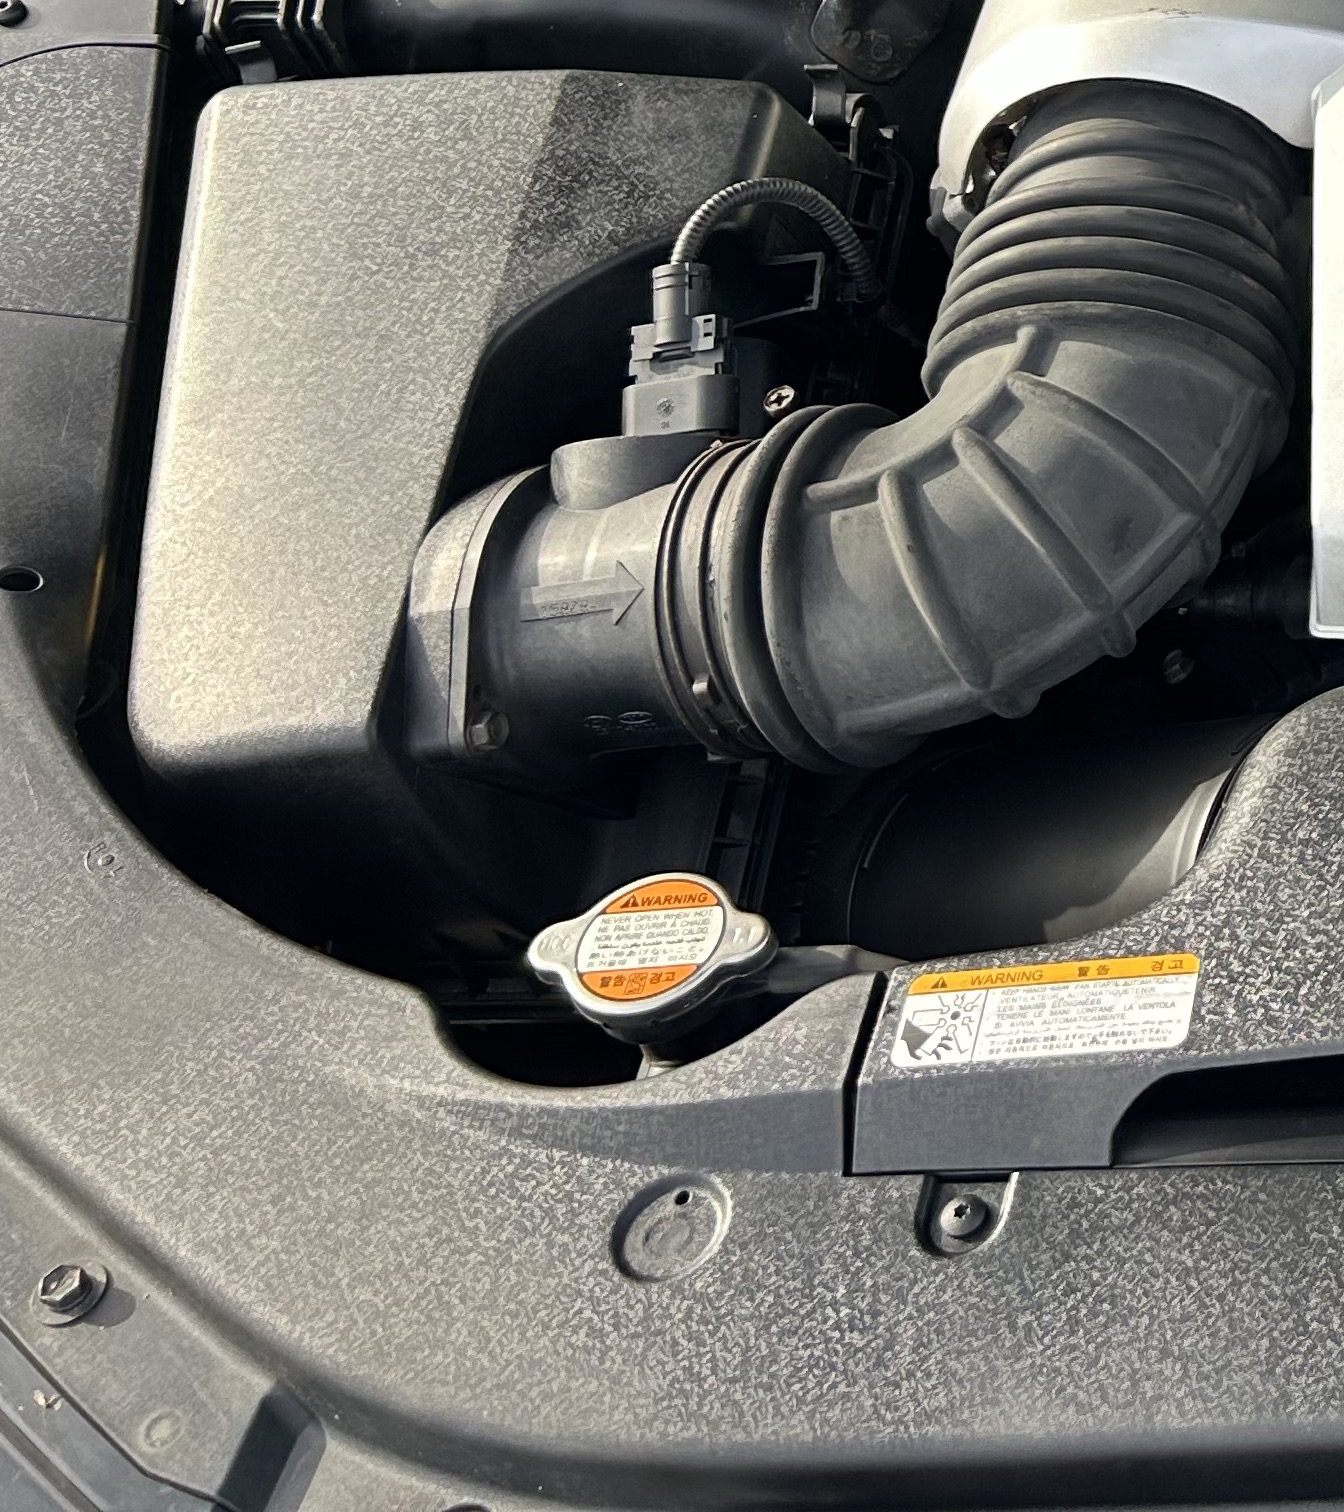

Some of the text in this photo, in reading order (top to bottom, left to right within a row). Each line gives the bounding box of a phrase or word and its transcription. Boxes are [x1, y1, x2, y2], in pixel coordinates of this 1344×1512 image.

[641, 893, 708, 906] WARNING
[601, 916, 631, 925] NEVER
[635, 913, 660, 923] OPEN
[664, 911, 691, 921] WHEN
[614, 923, 629, 932] PAS
[594, 934, 612, 942] NON
[970, 970, 1044, 986] WARNING
